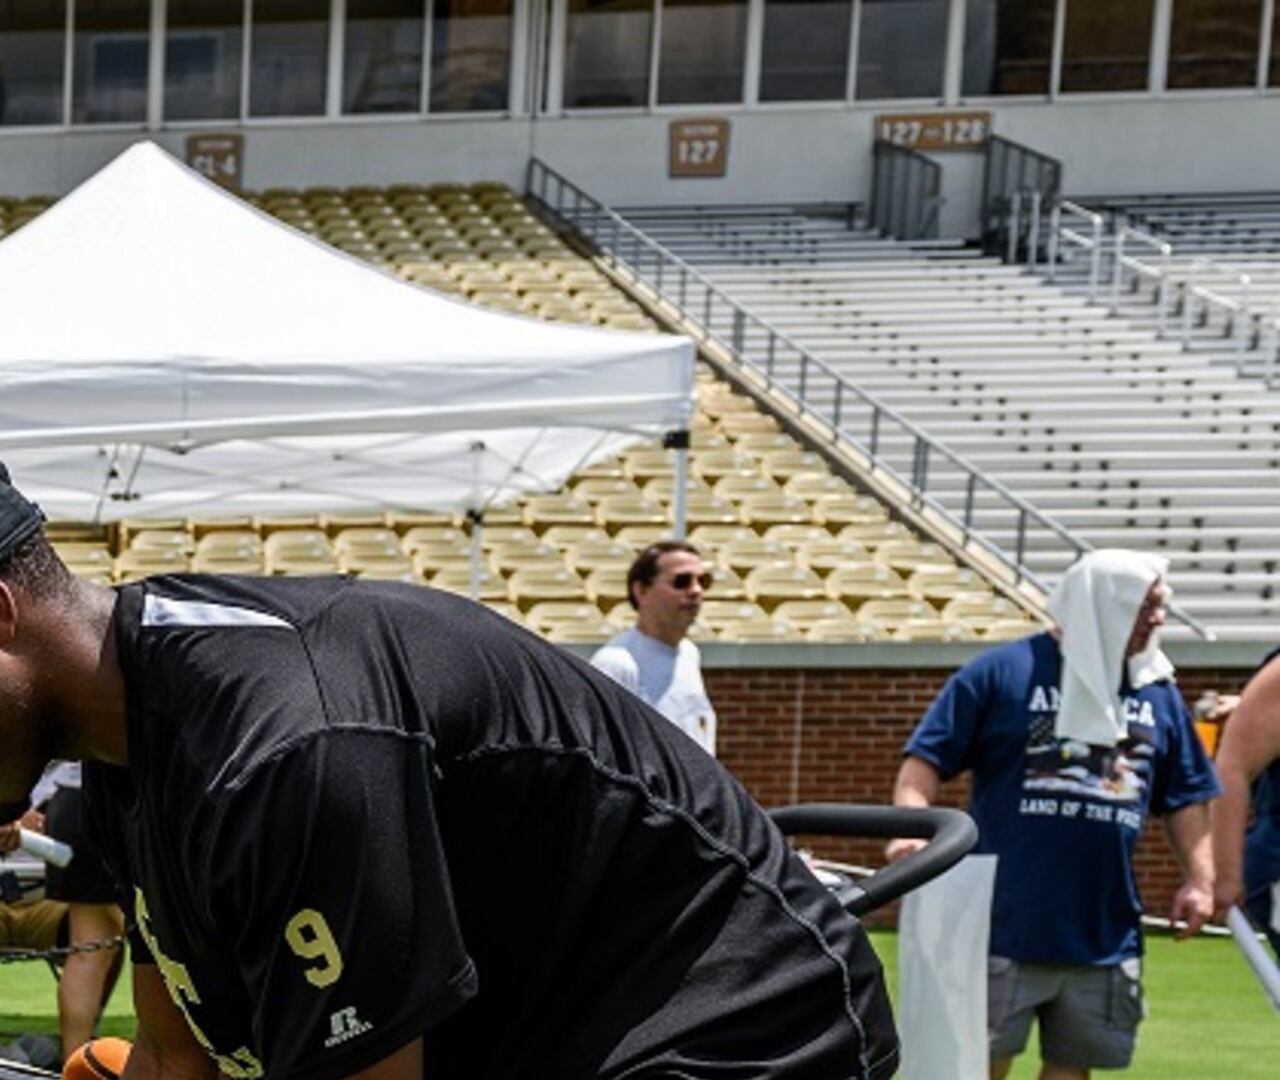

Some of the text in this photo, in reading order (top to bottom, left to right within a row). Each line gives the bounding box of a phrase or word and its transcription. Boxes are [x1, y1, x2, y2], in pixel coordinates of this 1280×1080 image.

[679, 140, 719, 164] 127
[1019, 798, 1058, 816] LAND
[1060, 801, 1082, 818] OF
[285, 908, 344, 989] 9
